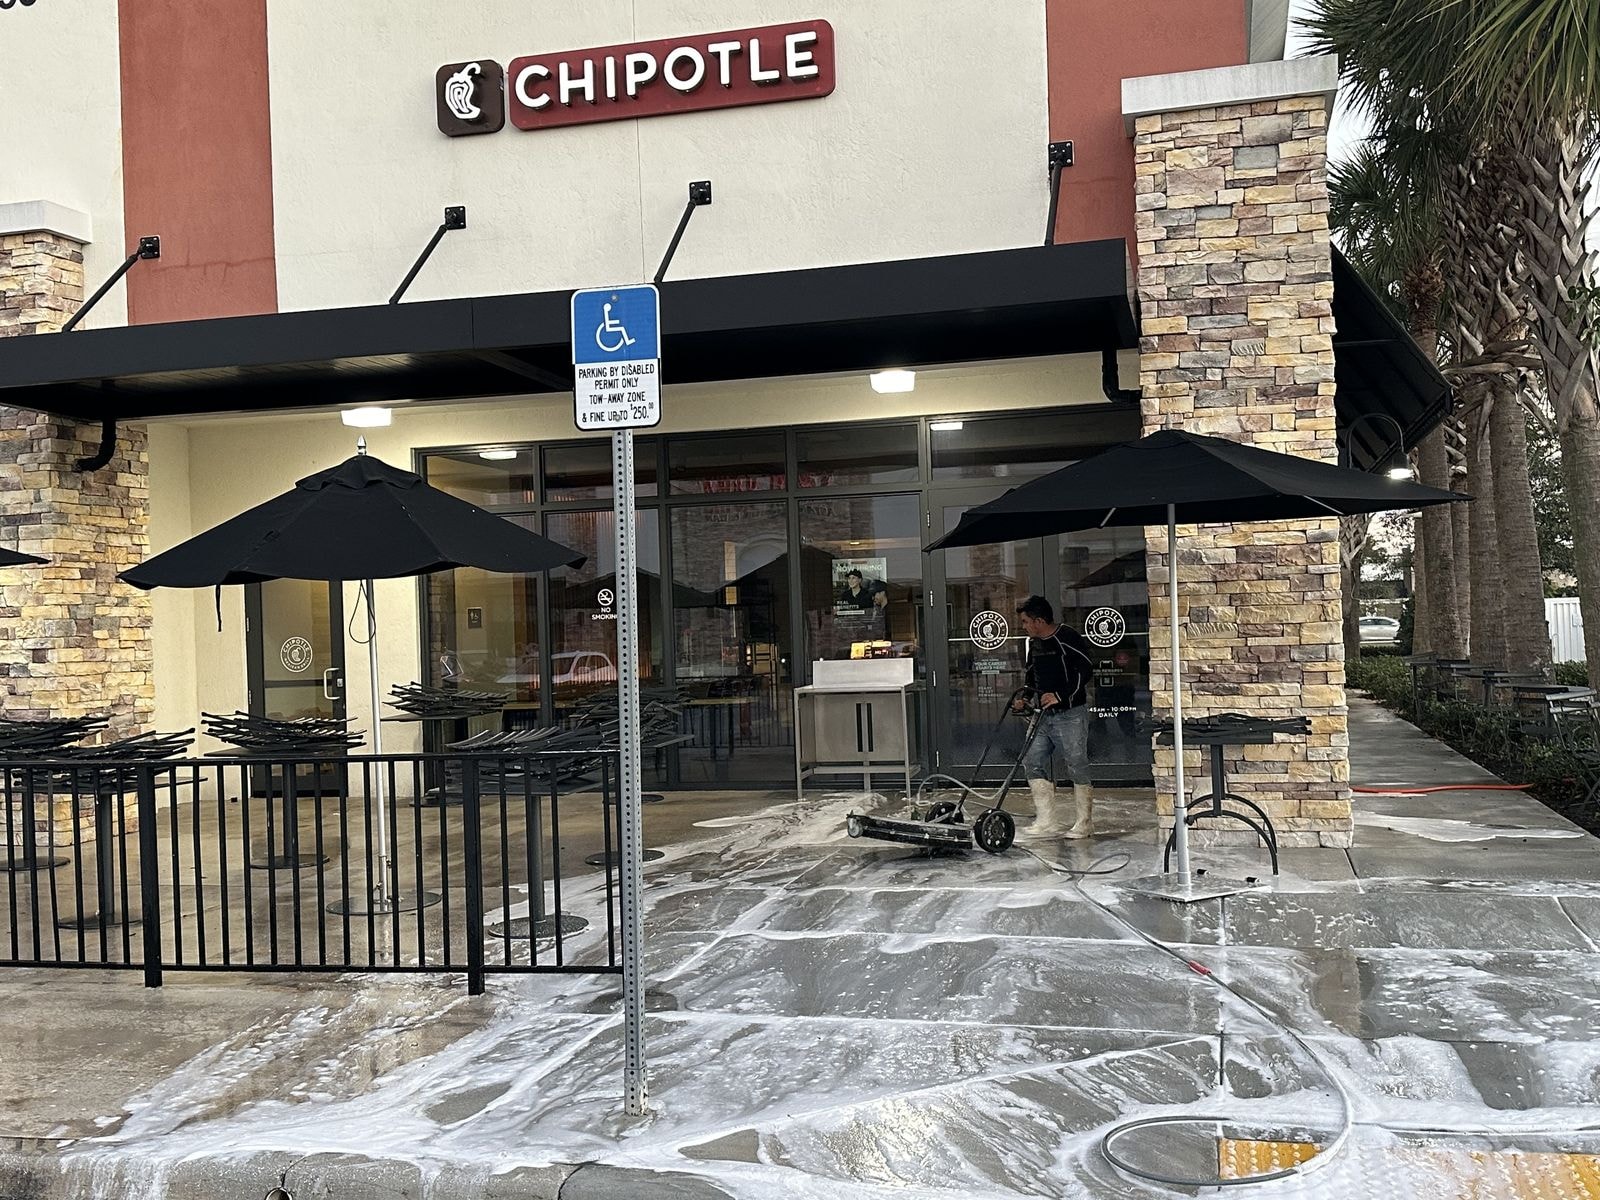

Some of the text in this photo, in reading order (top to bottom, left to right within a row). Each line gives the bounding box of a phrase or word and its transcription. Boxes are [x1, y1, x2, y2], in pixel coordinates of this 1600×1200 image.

[515, 31, 819, 108] CHIPOTLE
[578, 363, 655, 379] PARKING BY DISABLED
[594, 377, 639, 390] PERMIT ONLY
[589, 391, 646, 405] TOW-AWAY ZONE
[582, 412, 588, 423] &
[590, 411, 605, 422] FINE
[608, 411, 618, 422] UP
[619, 410, 628, 421] TO
[836, 564, 855, 572] NOW
[972, 613, 1005, 628] CHIPOTLE
[1088, 610, 1122, 625] CHIPOTLE
[282, 639, 310, 653] CHIPOTLE
